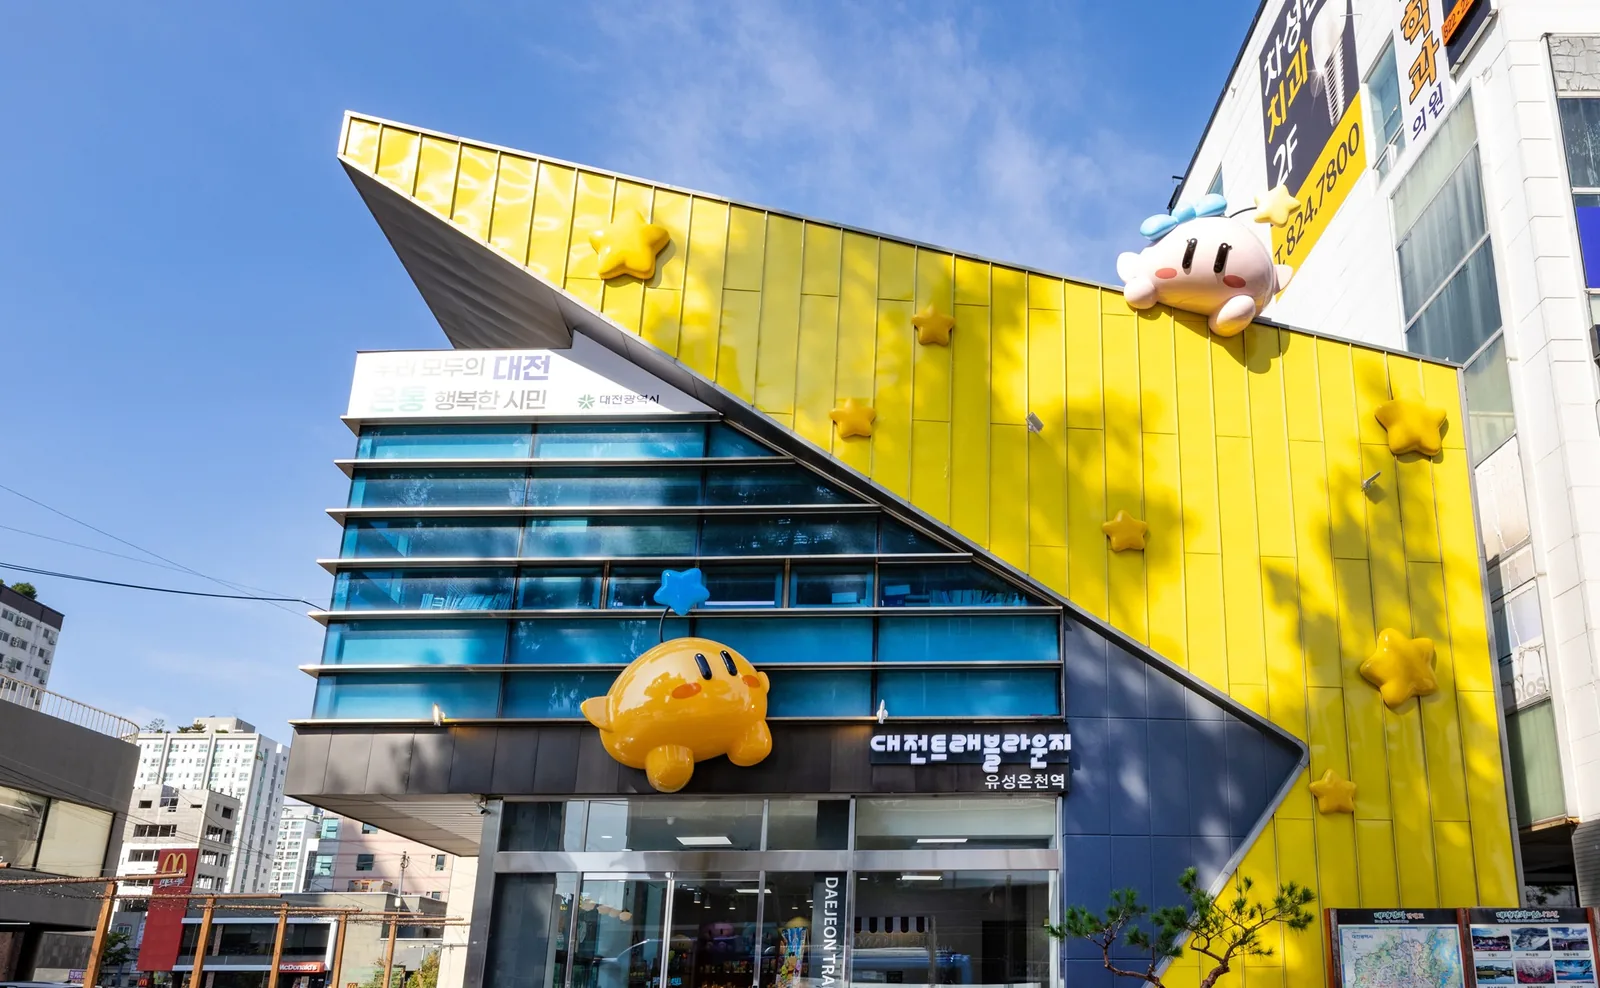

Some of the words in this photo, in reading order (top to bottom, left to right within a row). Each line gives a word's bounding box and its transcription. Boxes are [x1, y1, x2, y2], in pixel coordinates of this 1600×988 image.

[1267, 38, 1309, 144] 치과
[1412, 81, 1445, 141] 의원
[1273, 123, 1298, 187] 2F
[1286, 121, 1360, 257] 824.7800
[421, 356, 486, 377] 모두의
[492, 354, 552, 381] 대전
[434, 389, 501, 411] 행복한
[503, 389, 547, 410] 시민
[599, 394, 660, 405] 대전광역시
[870, 733, 1072, 773] 대전트래블라운지
[984, 773, 1065, 790] 유성온천역
[823, 877, 839, 951] DAEJEON
[821, 953, 836, 988] TRA
